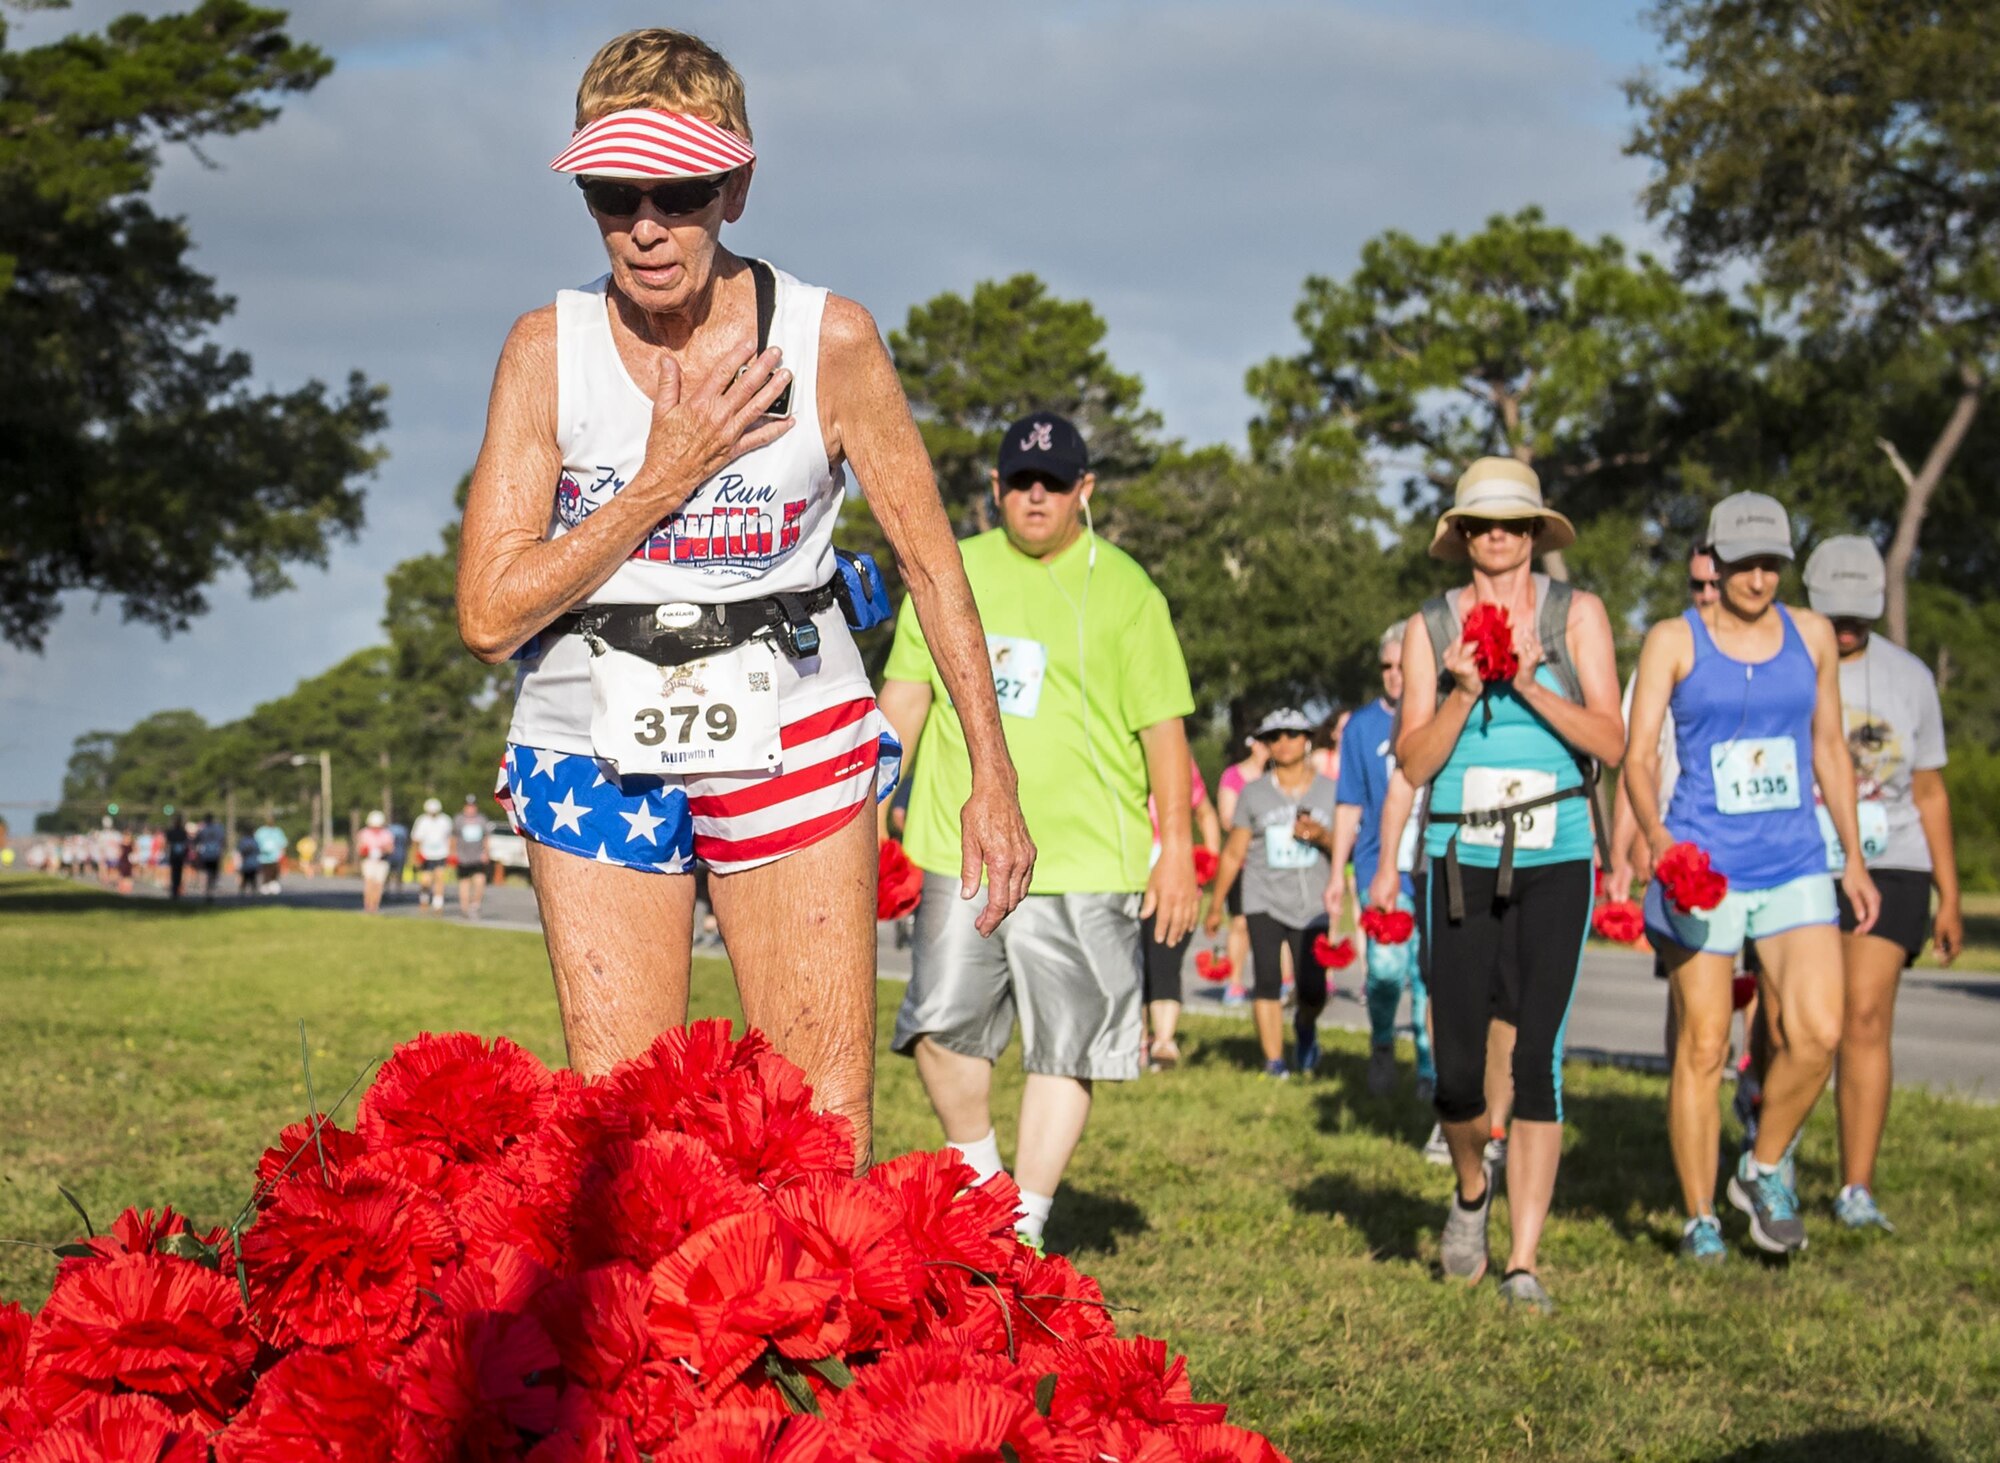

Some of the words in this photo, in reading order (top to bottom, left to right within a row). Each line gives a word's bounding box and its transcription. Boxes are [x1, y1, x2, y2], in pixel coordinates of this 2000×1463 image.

[714, 474, 778, 504] Run
[634, 703, 737, 746] 379
[1732, 776, 1788, 797] 1335
